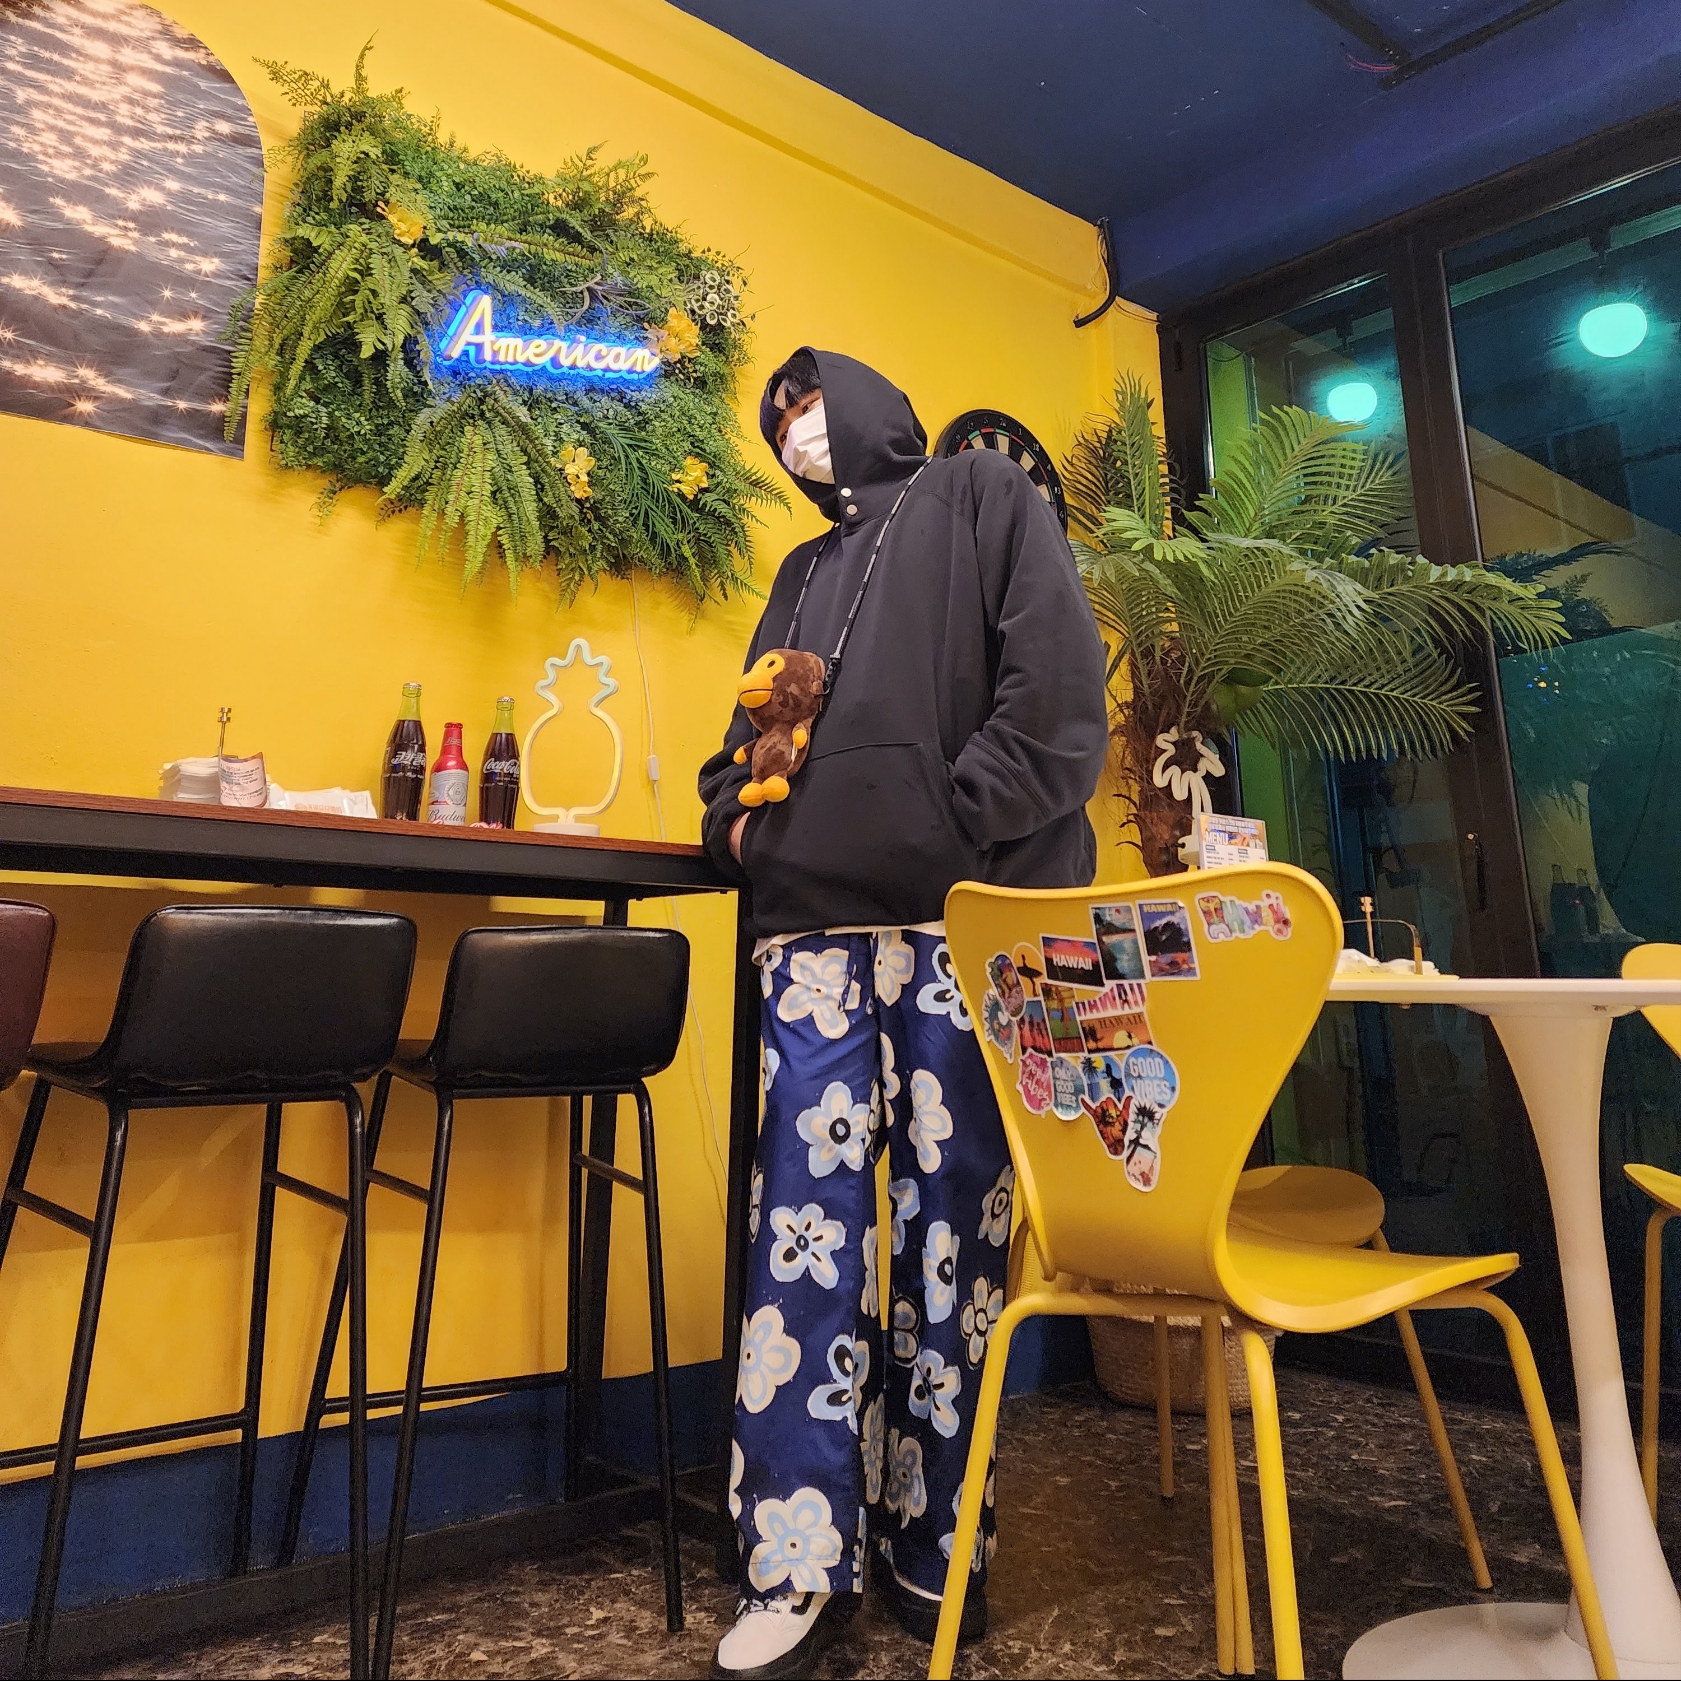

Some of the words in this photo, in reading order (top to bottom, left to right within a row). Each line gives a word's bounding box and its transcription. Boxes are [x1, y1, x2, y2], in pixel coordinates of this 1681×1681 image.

[450, 293, 661, 373] American
[1205, 831, 1228, 846] MENU
[1143, 903, 1180, 913] HAWAII
[1052, 953, 1093, 971] HAWAII
[1099, 1013, 1143, 1029] HAWAII
[1129, 1057, 1165, 1078] GOOD
[1131, 1079, 1171, 1101] VIBES
